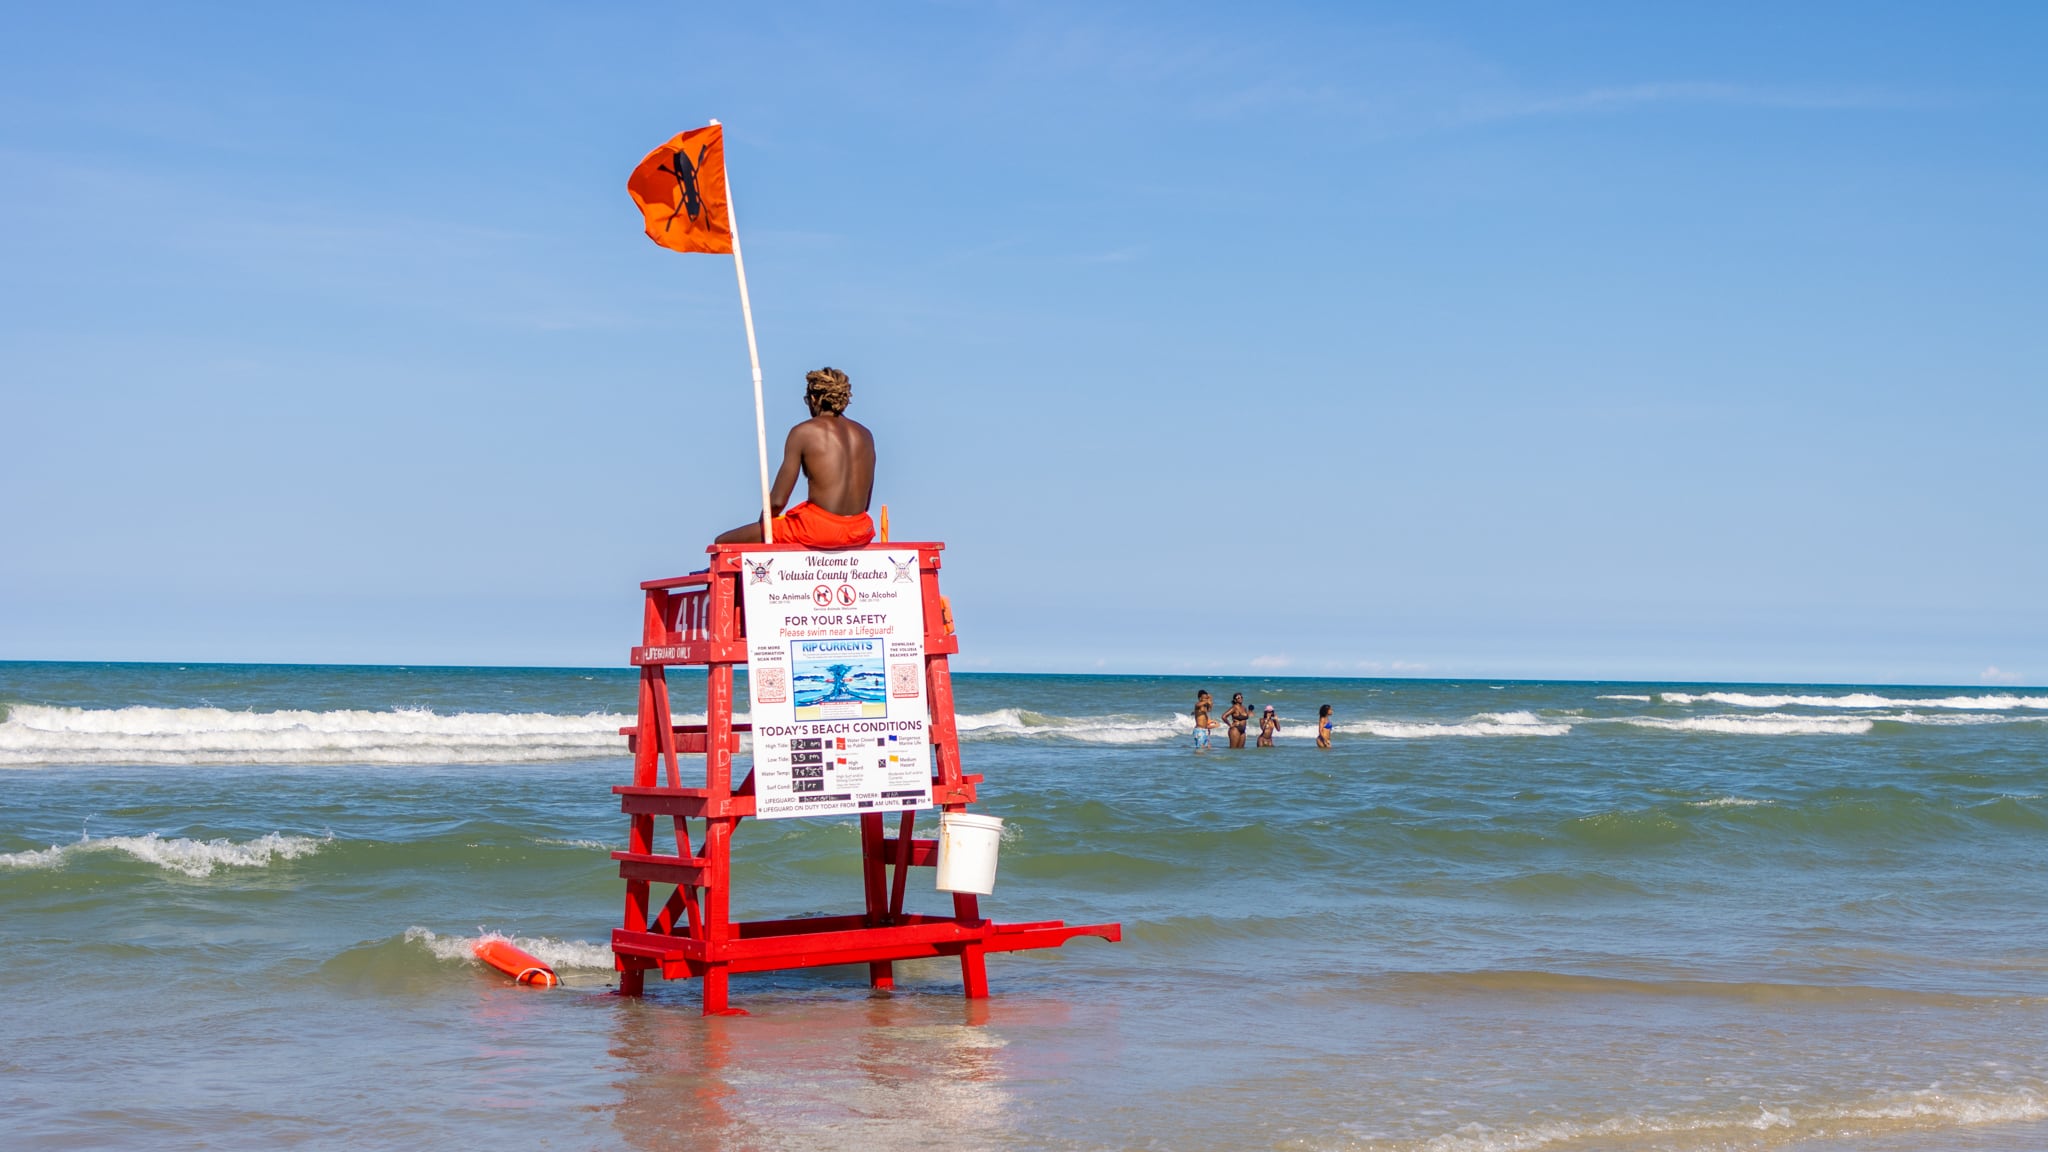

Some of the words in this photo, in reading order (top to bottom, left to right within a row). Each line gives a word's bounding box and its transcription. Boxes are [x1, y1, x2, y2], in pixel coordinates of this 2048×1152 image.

[805, 555, 849, 567] Welcome
[850, 555, 859, 566] to
[777, 569, 814, 581] Volusia
[816, 568, 849, 583] County
[851, 567, 888, 580] Beaches
[769, 593, 780, 601] No
[782, 592, 811, 601] Animals
[858, 591, 870, 599] No
[871, 590, 898, 599] Alcohol
[785, 616, 808, 626] FOR
[811, 615, 843, 625] YOUR
[846, 614, 887, 624] SAFETY
[779, 628, 805, 637] Please
[807, 628, 828, 637] swim
[829, 628, 847, 636] near
[848, 628, 854, 636] a
[855, 626, 894, 637] Lifeguard!
[802, 642, 818, 652] RIP
[819, 640, 873, 652] CURRENTS
[759, 725, 808, 737] TODAY'S
[812, 723, 850, 734] BEACH
[853, 720, 922, 733] CONDITIONS
[763, 805, 793, 813] LIFEGUARD
